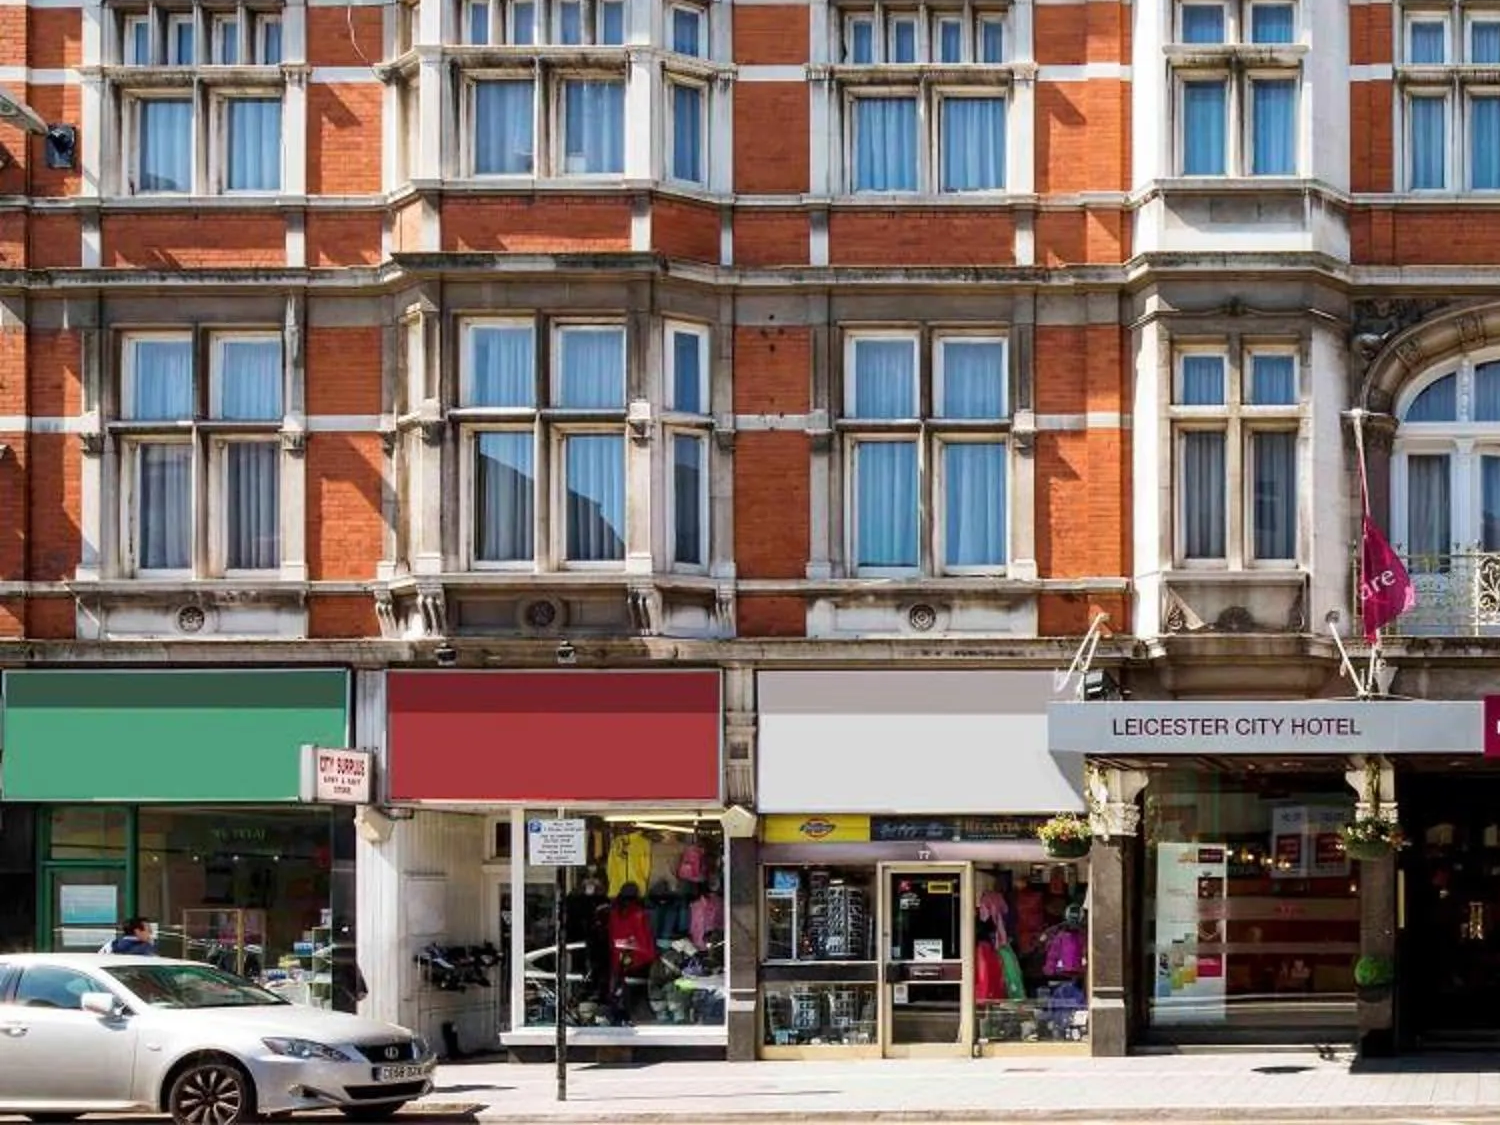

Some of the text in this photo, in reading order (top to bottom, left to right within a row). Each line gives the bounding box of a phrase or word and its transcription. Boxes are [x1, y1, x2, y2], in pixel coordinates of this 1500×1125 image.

[1112, 718, 1362, 736] LEICESTER CITY HOTEL
[917, 849, 931, 860] 77
